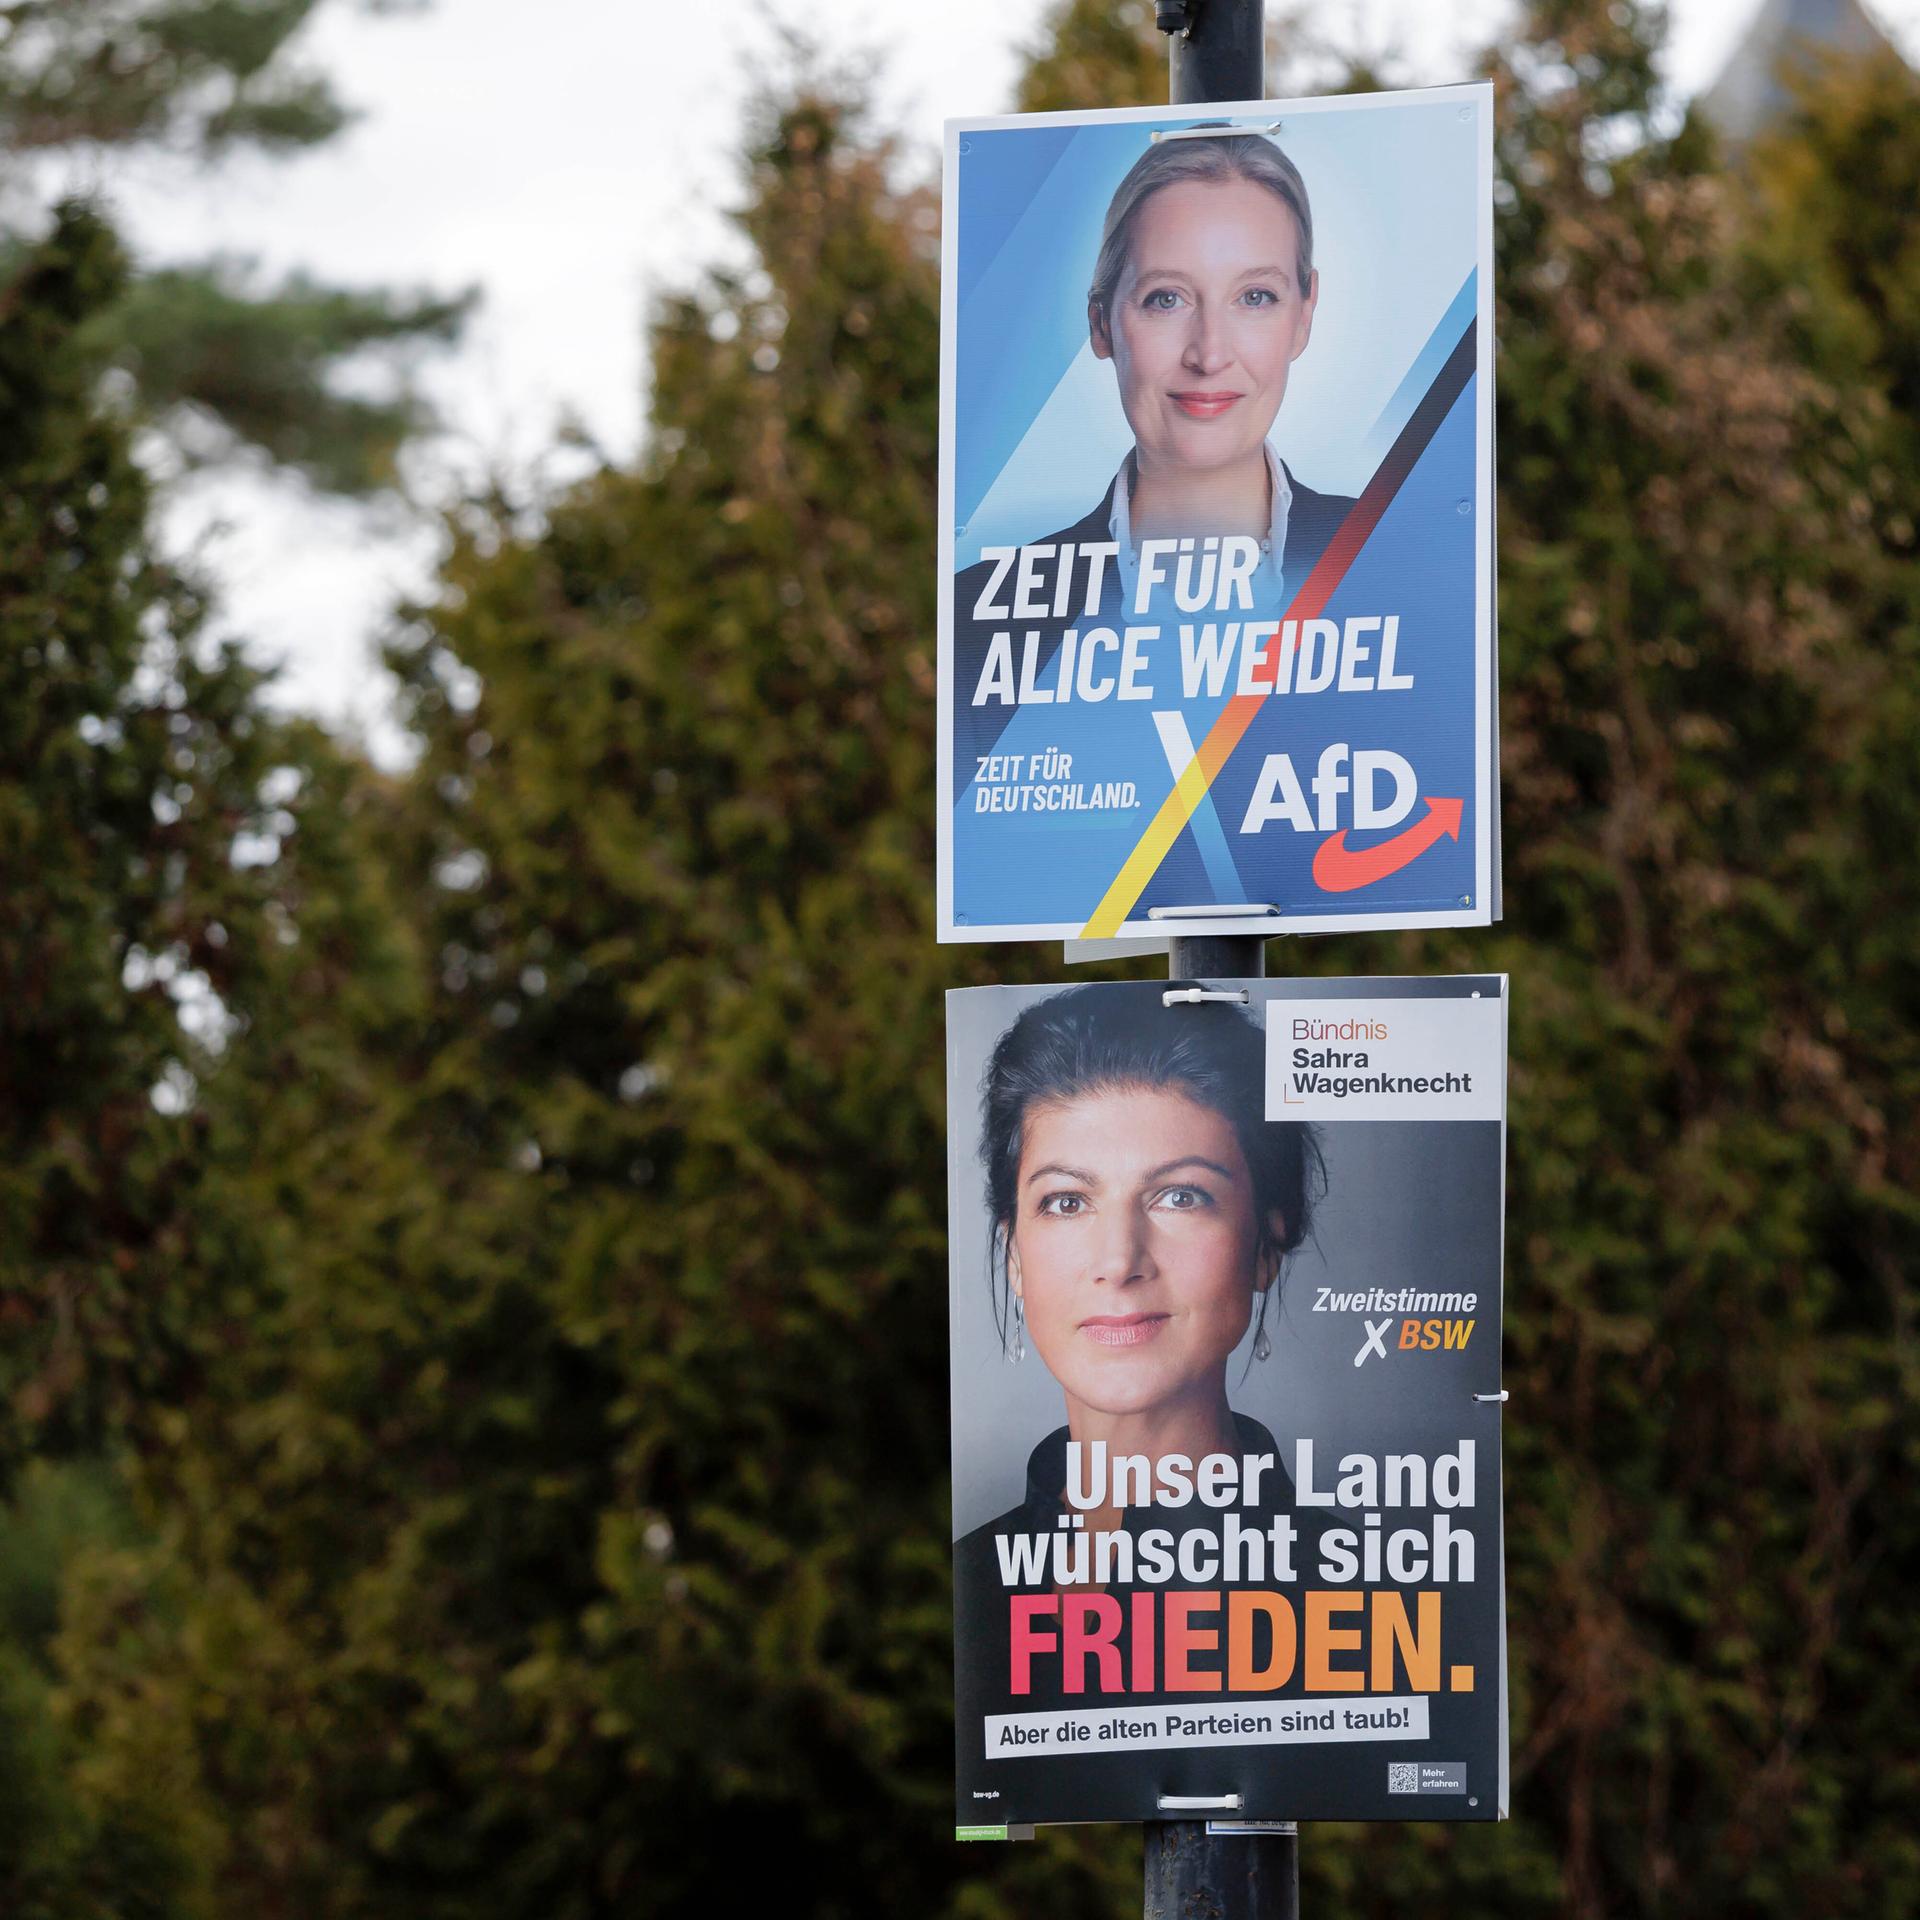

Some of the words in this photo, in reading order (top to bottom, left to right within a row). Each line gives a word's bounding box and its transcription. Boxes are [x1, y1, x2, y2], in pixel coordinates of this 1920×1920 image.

[972, 541, 1120, 620] ZEIT
[1134, 536, 1260, 614] FÜR
[971, 626, 1161, 706] ALICE
[1178, 615, 1415, 698] WEIDEL
[974, 755, 1025, 782] ZEIT
[1028, 746, 1073, 781] FÜR
[975, 782, 1141, 813] DEUTSCHLAND.
[1239, 743, 1418, 834] AfD
[1292, 1018, 1388, 1041] Bündnis
[1292, 1048, 1369, 1069] Sahra
[1292, 1073, 1472, 1098] Wagenknecht
[1312, 1287, 1478, 1312] Zweitstimme
[1398, 1318, 1476, 1351] BSW
[1066, 1440, 1274, 1510] Unser
[1295, 1439, 1475, 1508] Land
[995, 1513, 1297, 1587] wünscht
[1318, 1512, 1475, 1583] sich
[1010, 1590, 1474, 1695] FRIEDEN.
[1000, 1725, 1049, 1746] Aber
[1056, 1721, 1091, 1742] die
[1098, 1719, 1157, 1740] alten
[1165, 1713, 1272, 1737] Parteien
[1280, 1709, 1335, 1732] sind
[1343, 1707, 1410, 1730] taub!
[1422, 1768, 1446, 1777] Mehr
[1422, 1779, 1459, 1788] erfahren
